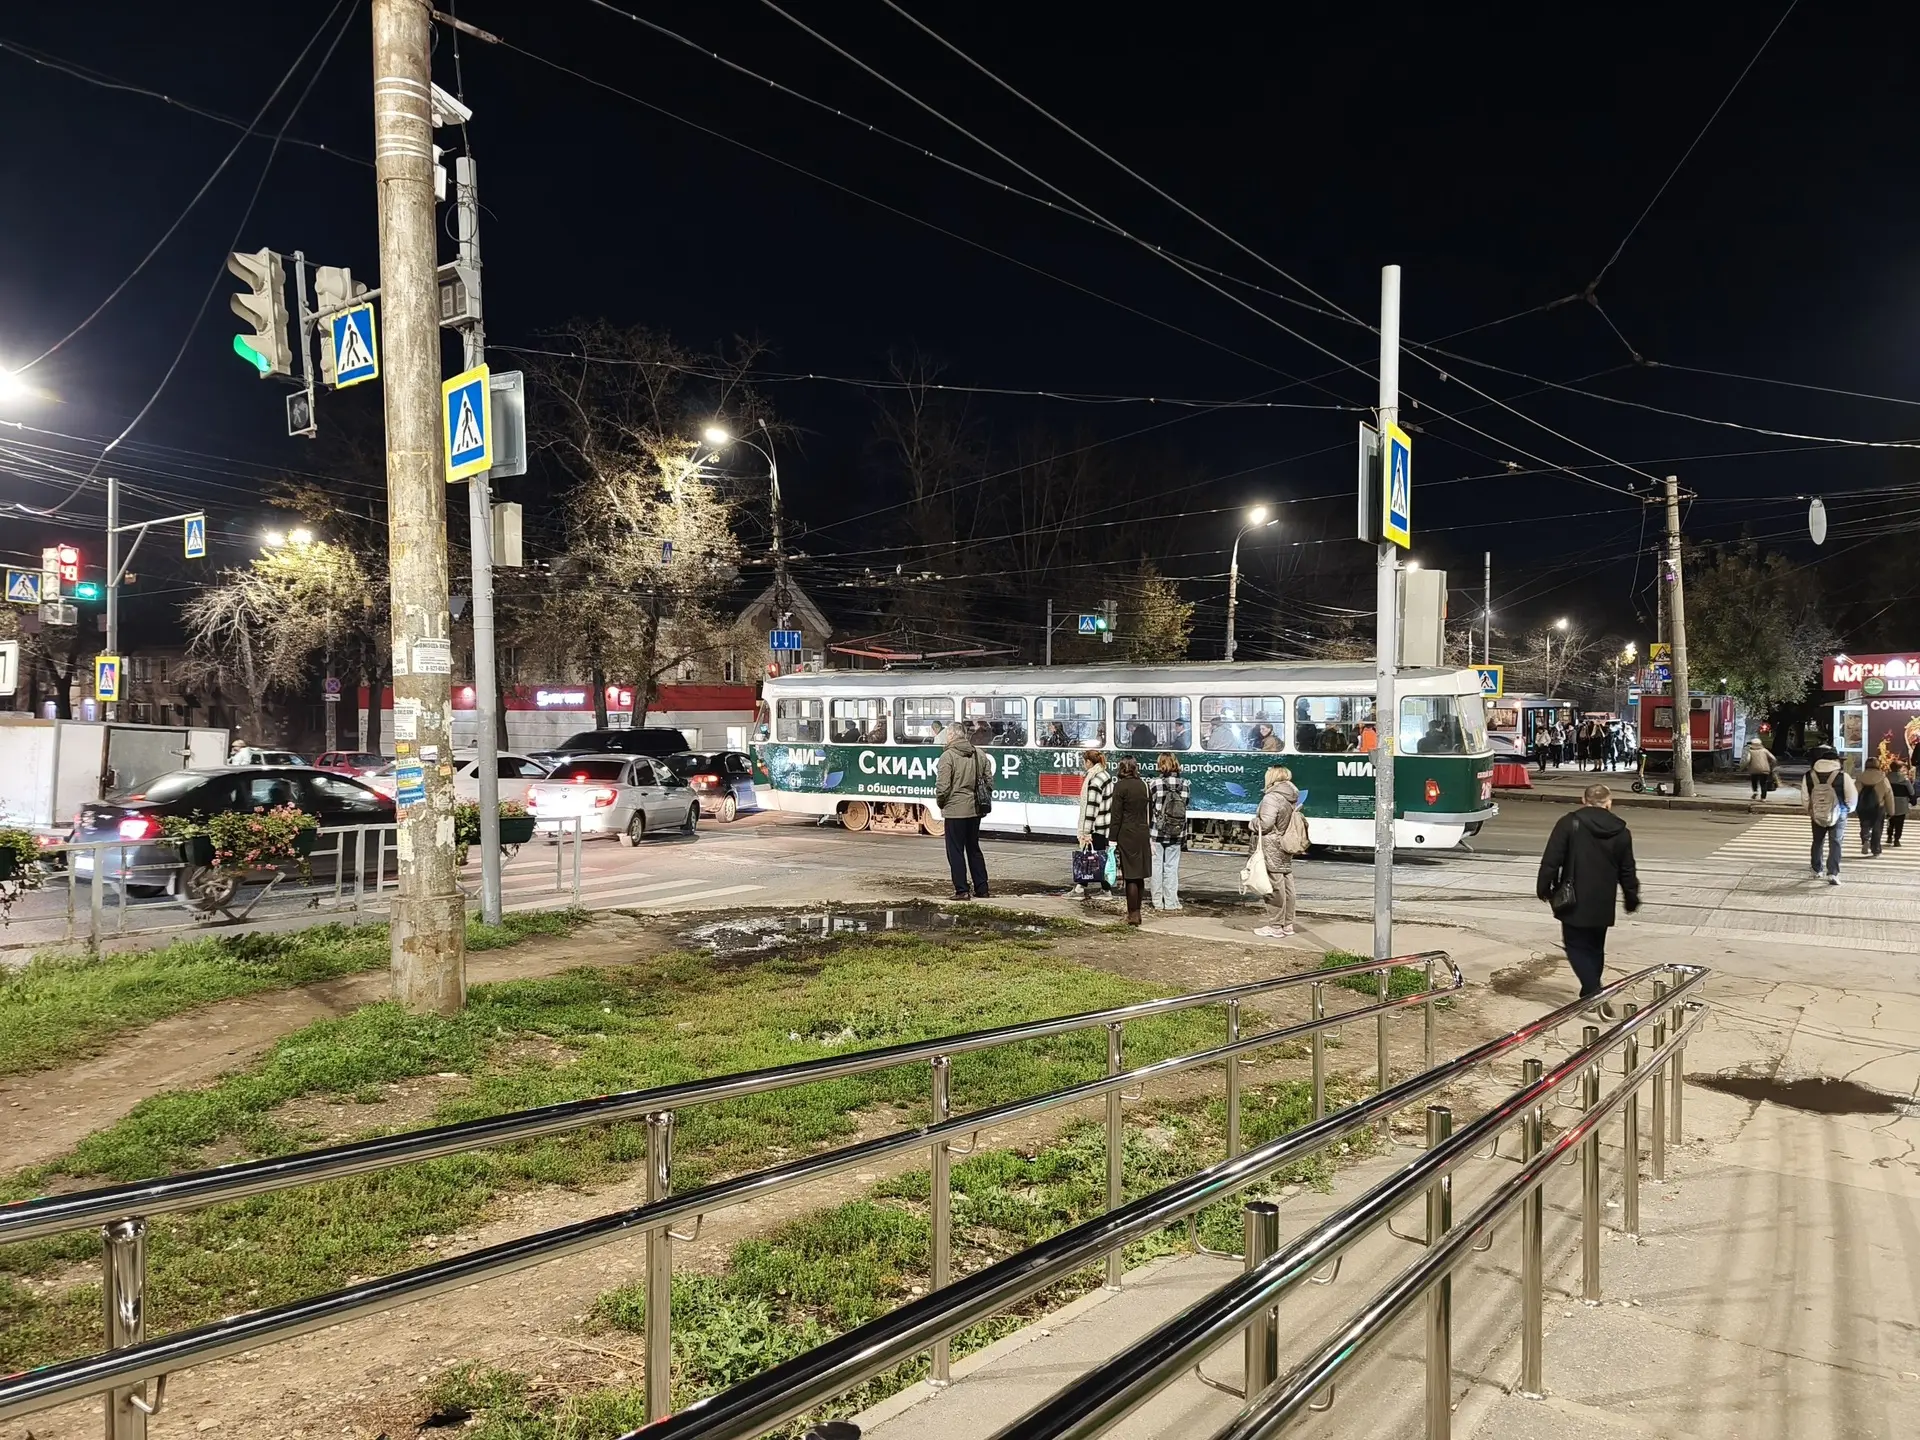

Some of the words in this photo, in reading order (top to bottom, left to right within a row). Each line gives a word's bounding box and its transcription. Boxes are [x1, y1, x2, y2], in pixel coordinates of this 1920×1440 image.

[1833, 658, 1920, 682] МЯСНЙ
[858, 750, 940, 780] Скидк
[1106, 761, 1118, 771] пр
[1337, 761, 1376, 777] МИ
[991, 789, 1020, 800] орте
